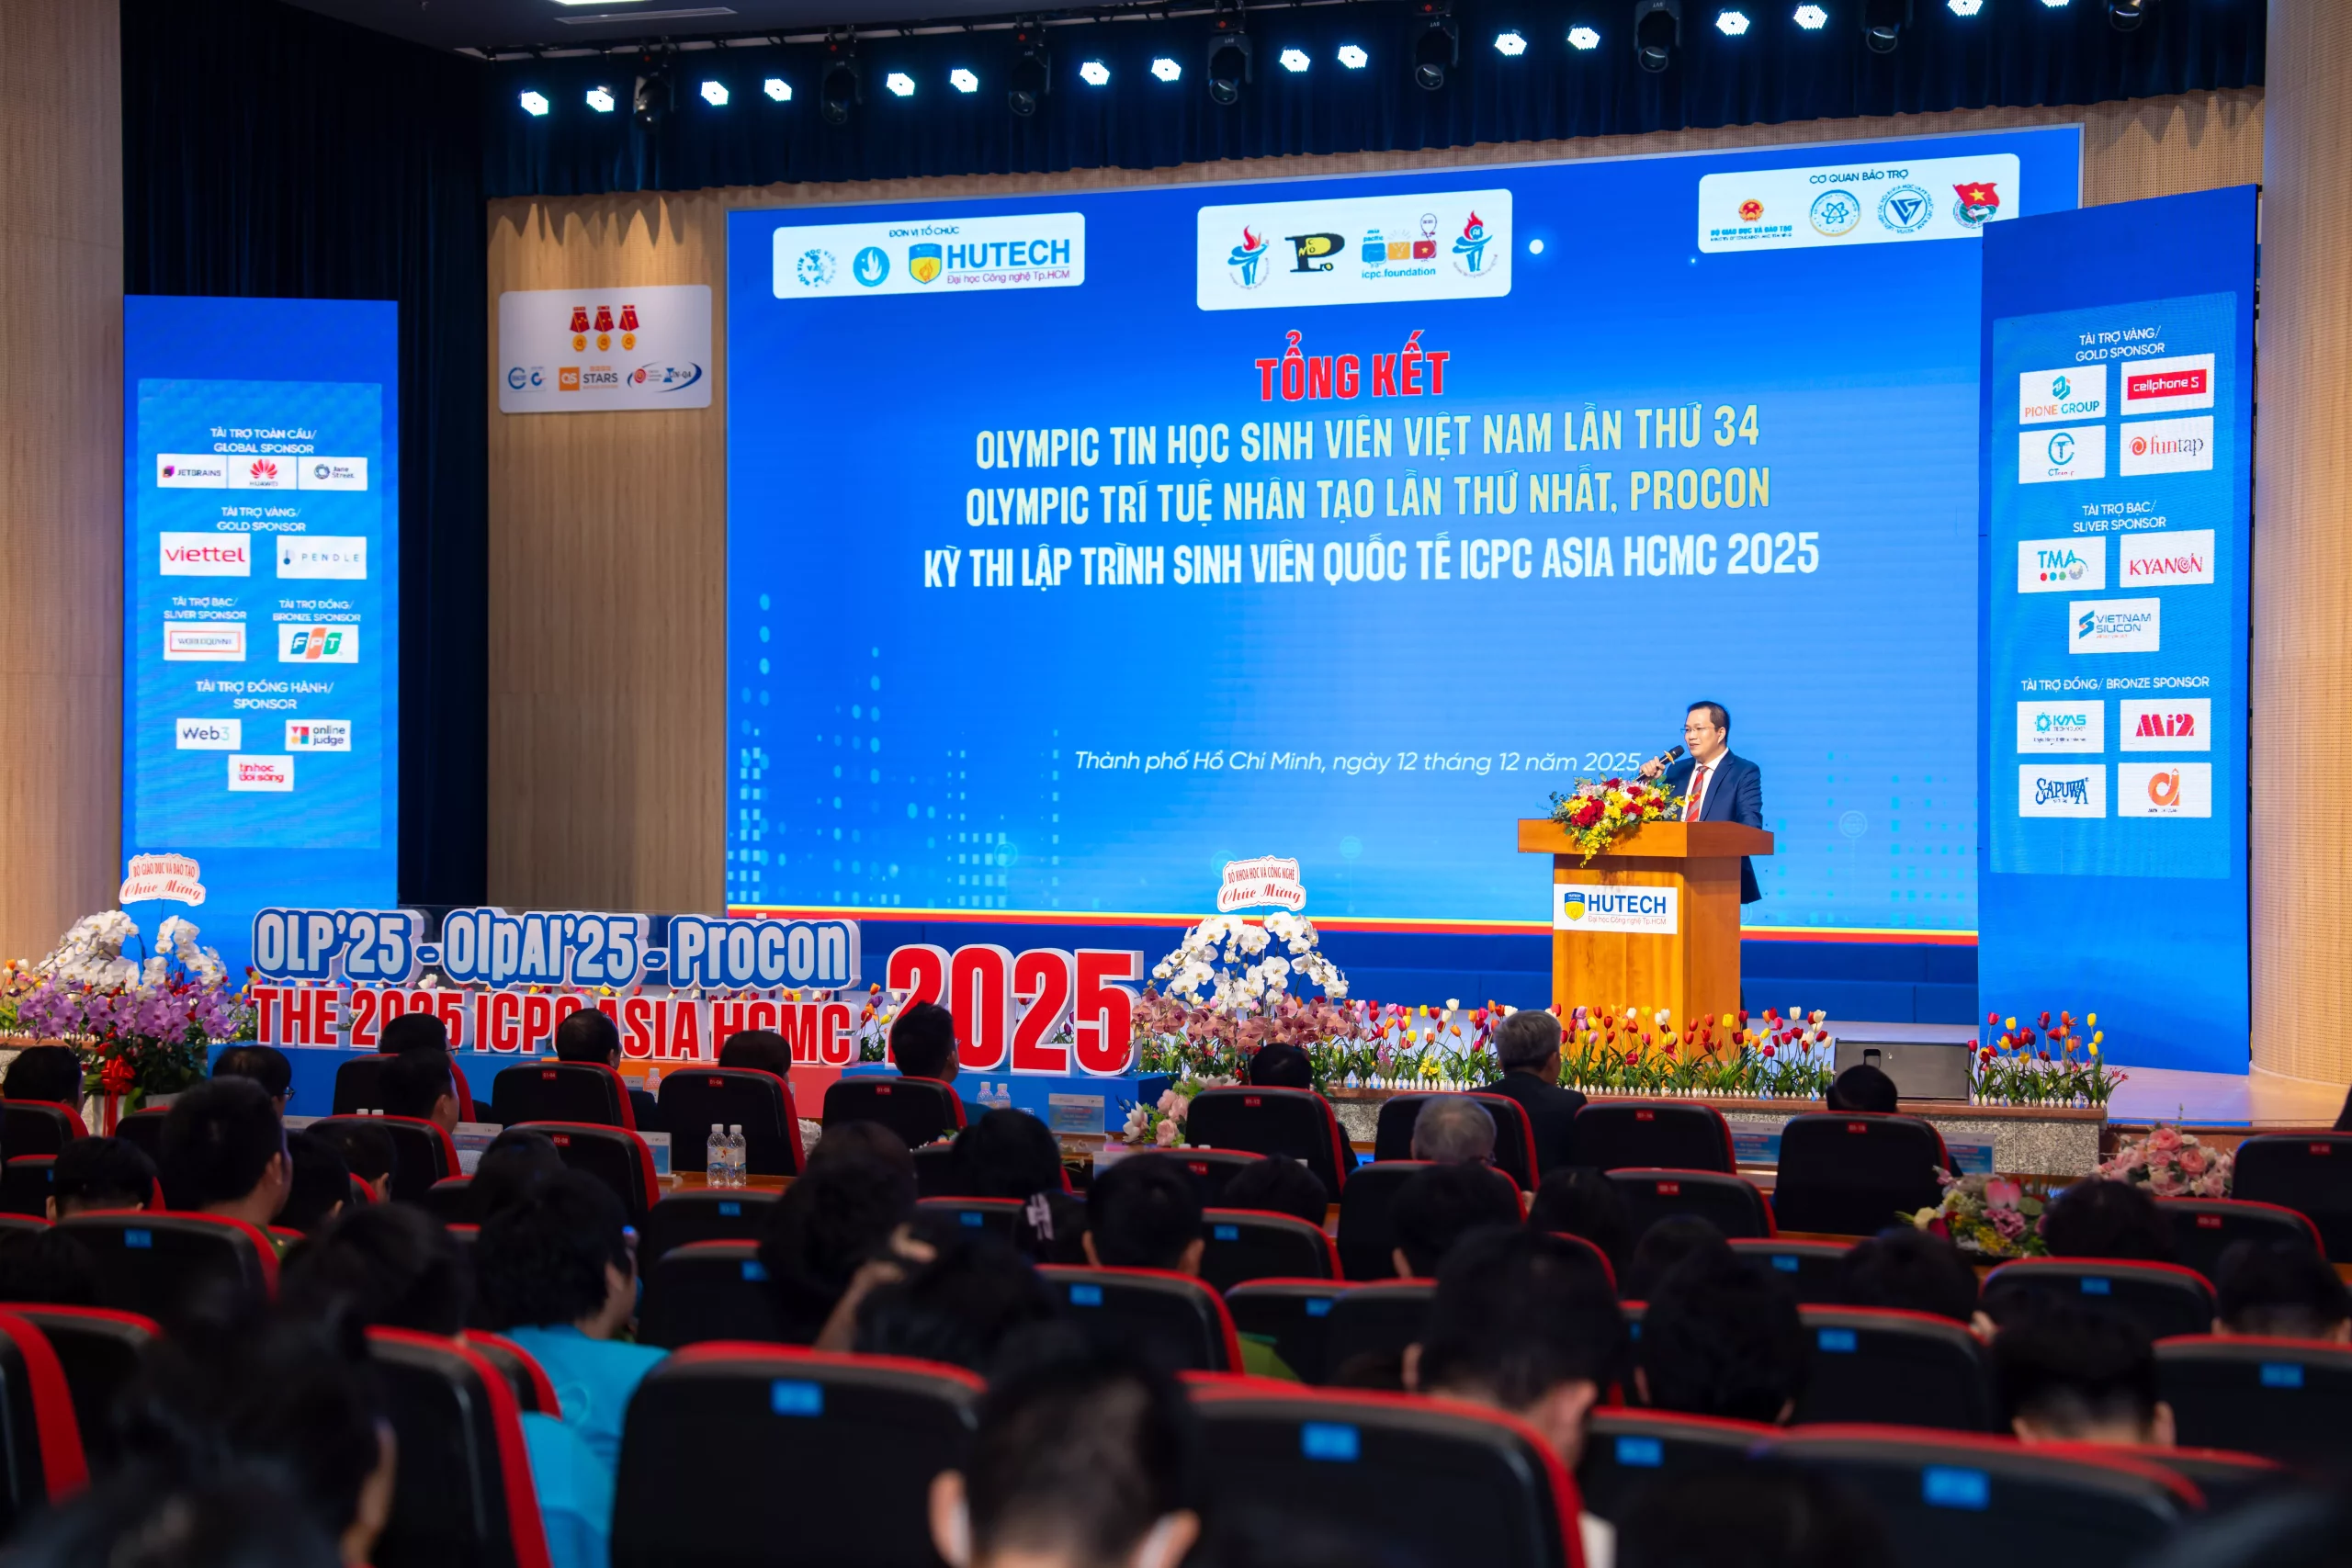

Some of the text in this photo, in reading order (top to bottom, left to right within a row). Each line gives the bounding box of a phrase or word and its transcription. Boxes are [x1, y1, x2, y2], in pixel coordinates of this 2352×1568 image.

[1809, 168, 1909, 185] CƠ QUAN BẢO TRỢ
[947, 239, 1070, 269] HUTECH
[947, 270, 1070, 284] Đại học Công nghệ Tp.HCM
[1361, 267, 1436, 280] icpc.foundation
[2079, 332, 2096, 346] TÀI
[2098, 331, 2121, 345] TRỢ
[2075, 342, 2165, 362] GOLD SPONSOR
[1255, 329, 1450, 401] TỔNG KẾT
[561, 372, 577, 385] QS
[583, 372, 618, 384] STARS
[2024, 400, 2100, 418] PIONE GROUP
[976, 401, 1760, 469] OLYMPIC TIN HỌC SINH VIÊN VIỆT NAM LẦN THỨ 34
[214, 443, 314, 454] GLOBAL SPONSOR
[2150, 435, 2204, 457] funtap
[966, 462, 1770, 527] OLYMPIC TRÍ TUỆ NHÂN TẠO LẦN THỨ NHẤT, PROCON
[2082, 503, 2099, 516] TÀI
[2101, 502, 2125, 517] TRỢ
[216, 521, 306, 532] GOLD SPONSOR
[2073, 516, 2166, 533] SLIVER SPONSOR
[165, 546, 246, 563] viettel
[301, 553, 360, 562] PENDLE
[924, 531, 1820, 592] KỲ THI LẬP TRÌNH SINH VIÊN QUỐC TẾ ICPC ASIA HCMC 2025
[2038, 549, 2077, 569] TMA
[164, 610, 247, 620] SLIVER SPONSOR
[272, 613, 361, 622] BRONZE SPONSOR
[2096, 613, 2151, 623] VIETNAM
[2096, 624, 2141, 633] SILICON
[2021, 678, 2037, 691] TÀI
[2039, 678, 2062, 693] TRỢ
[2106, 677, 2150, 689] BRONZE
[2153, 676, 2210, 688] SPONSOR
[233, 699, 297, 710] SPONSOR
[2053, 715, 2086, 726] KMS
[183, 726, 230, 741] Web3
[313, 726, 345, 735] online
[312, 736, 345, 746] judge
[1075, 749, 1642, 776] Thành phố Hồ Chí Minh, ngày 12 tháng 12 năm 2025
[2035, 778, 2089, 805] SAPUWA
[1236, 868, 1249, 882] KHOA
[1250, 867, 1260, 881] HỌC
[1268, 864, 1281, 879] CÔNG
[124, 882, 158, 897] Chúc
[1222, 888, 1256, 905] Chúc
[1588, 894, 1666, 914] HUTECH
[677, 919, 848, 980] Procon
[253, 987, 342, 1047] THE
[474, 991, 583, 1054] ICP
